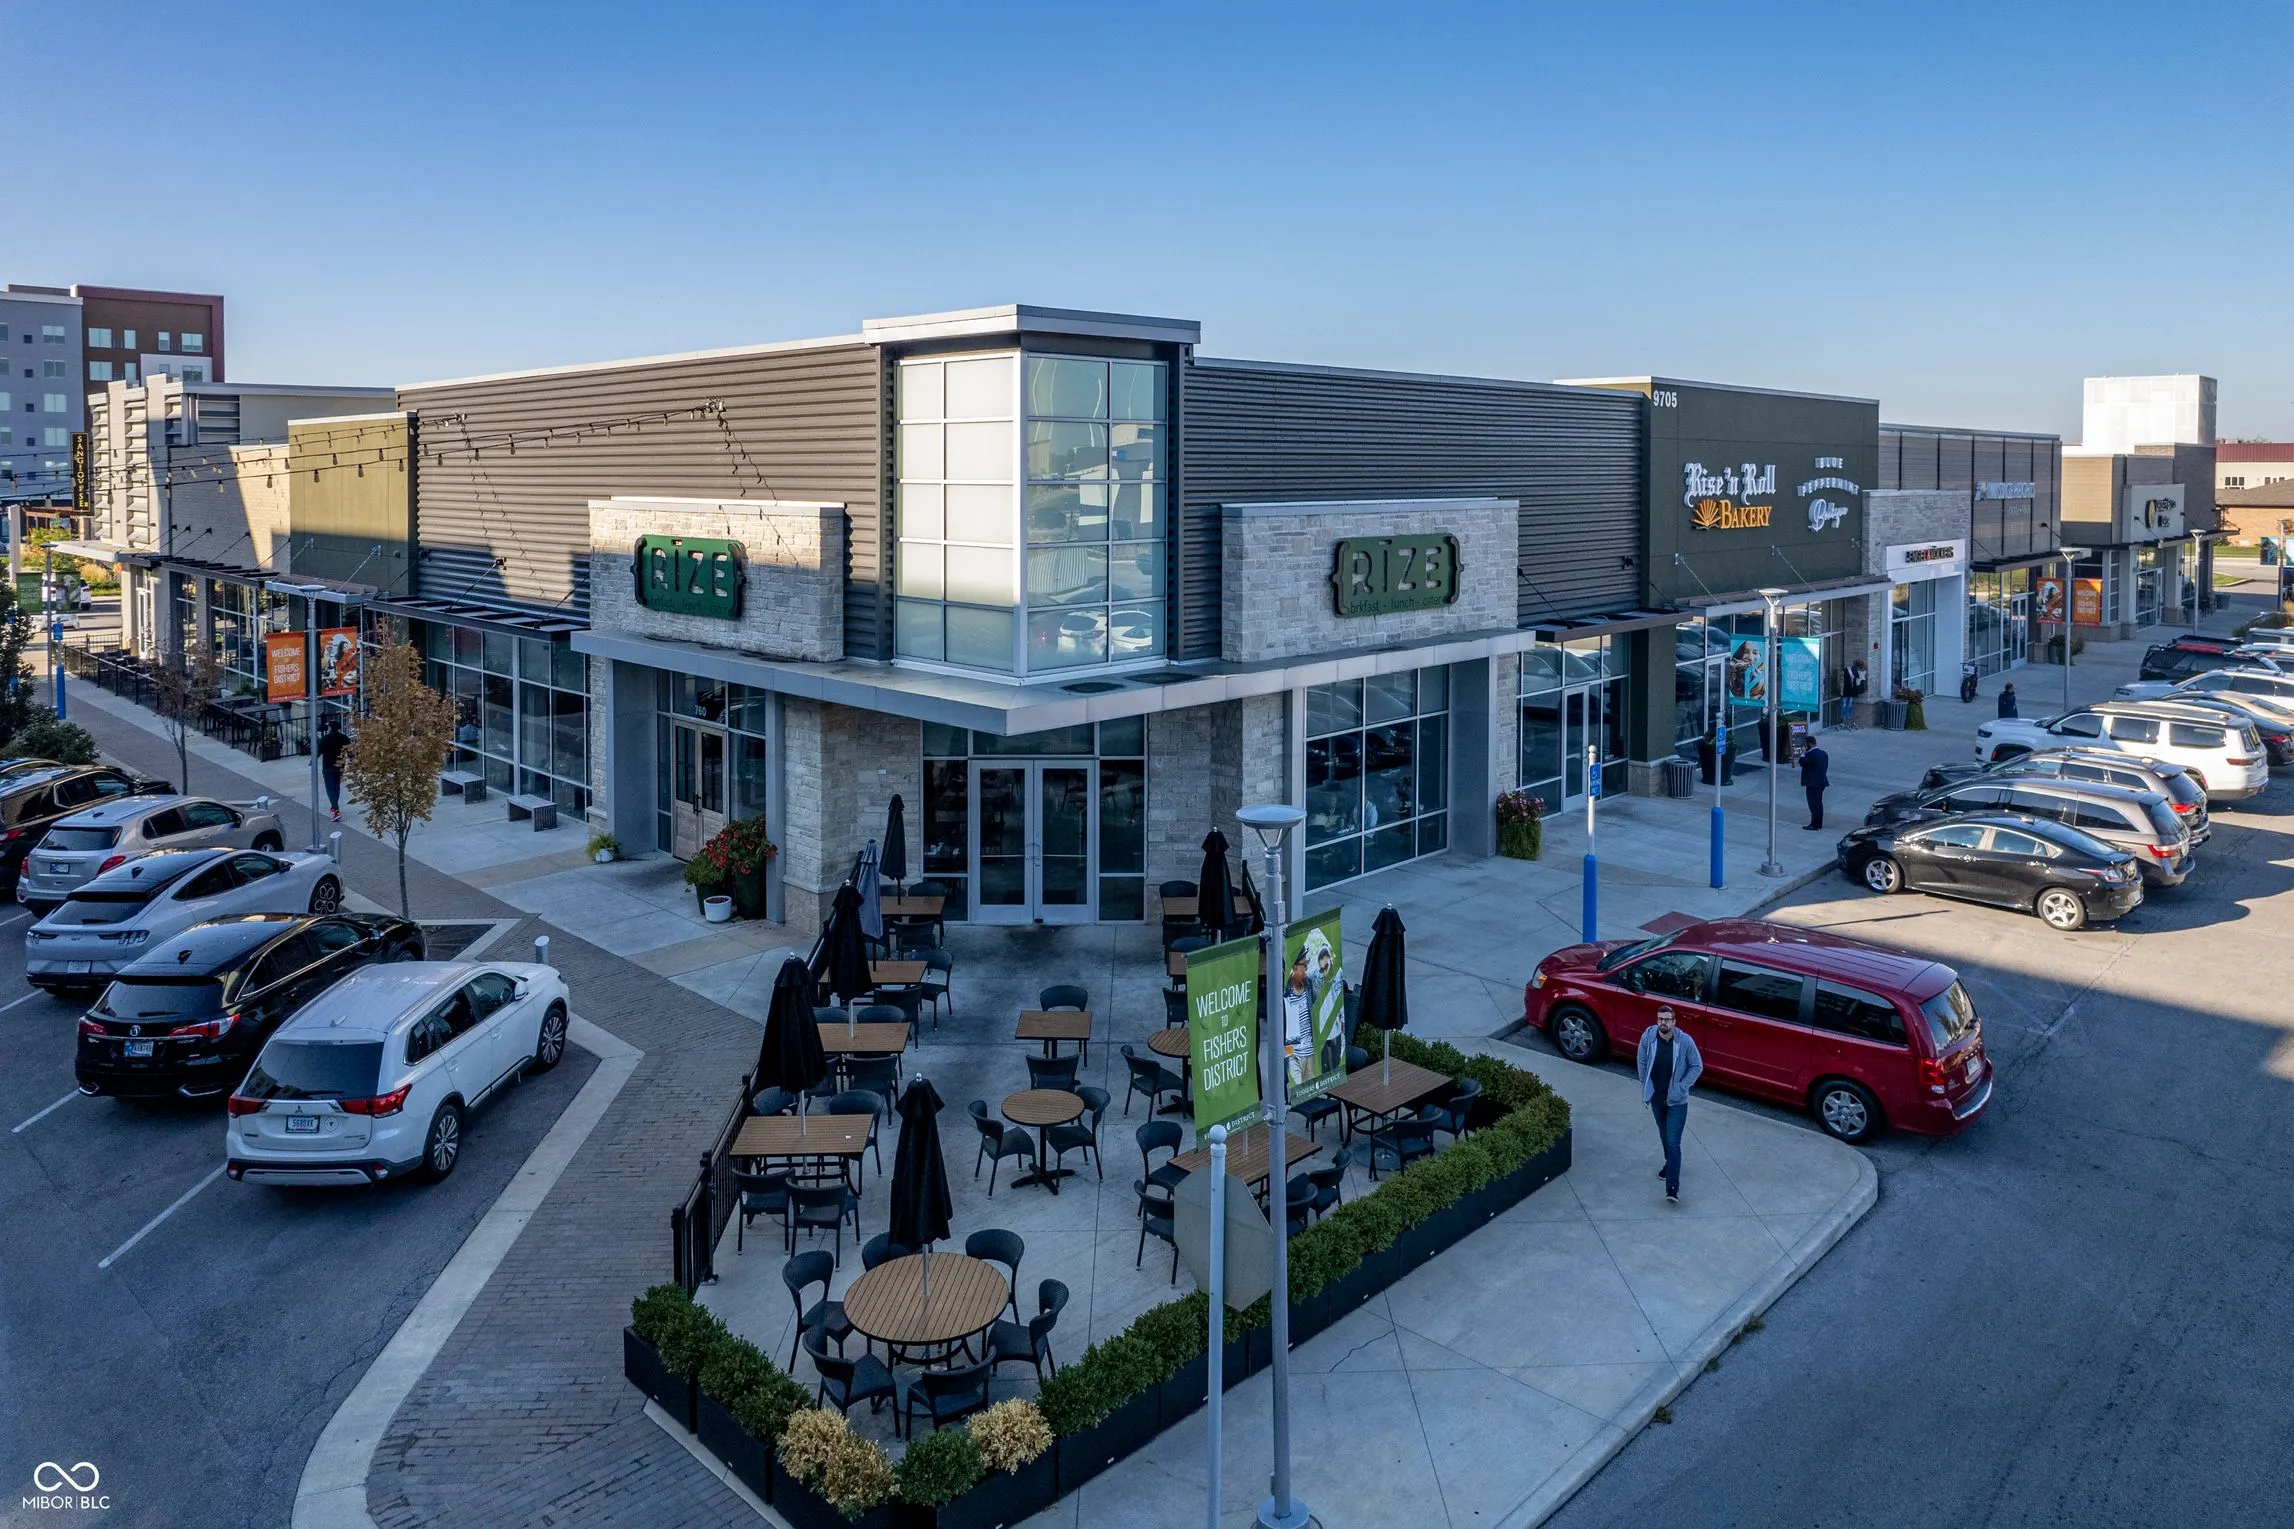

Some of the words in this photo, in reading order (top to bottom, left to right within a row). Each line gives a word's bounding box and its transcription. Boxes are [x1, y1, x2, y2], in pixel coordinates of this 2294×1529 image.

[1653, 390, 1677, 408] 9705
[1815, 457, 1843, 469] BLUE
[1741, 463, 1777, 506] Roll
[1797, 477, 1859, 497] PEPPERMINT
[1720, 500, 1773, 529] BAKERY
[1350, 600, 1380, 614] brkfast
[1391, 595, 1414, 609] lunch
[271, 647, 301, 658] WELCOME
[274, 663, 300, 674] FISHERS
[1196, 980, 1252, 1018] WELCOME
[1220, 1014, 1229, 1027] TO
[1203, 1025, 1247, 1062] FISHERS
[1203, 1051, 1249, 1091] DISTRICT
[1320, 1073, 1341, 1087] DISTRICT
[1231, 1111, 1255, 1128] DISTRICT
